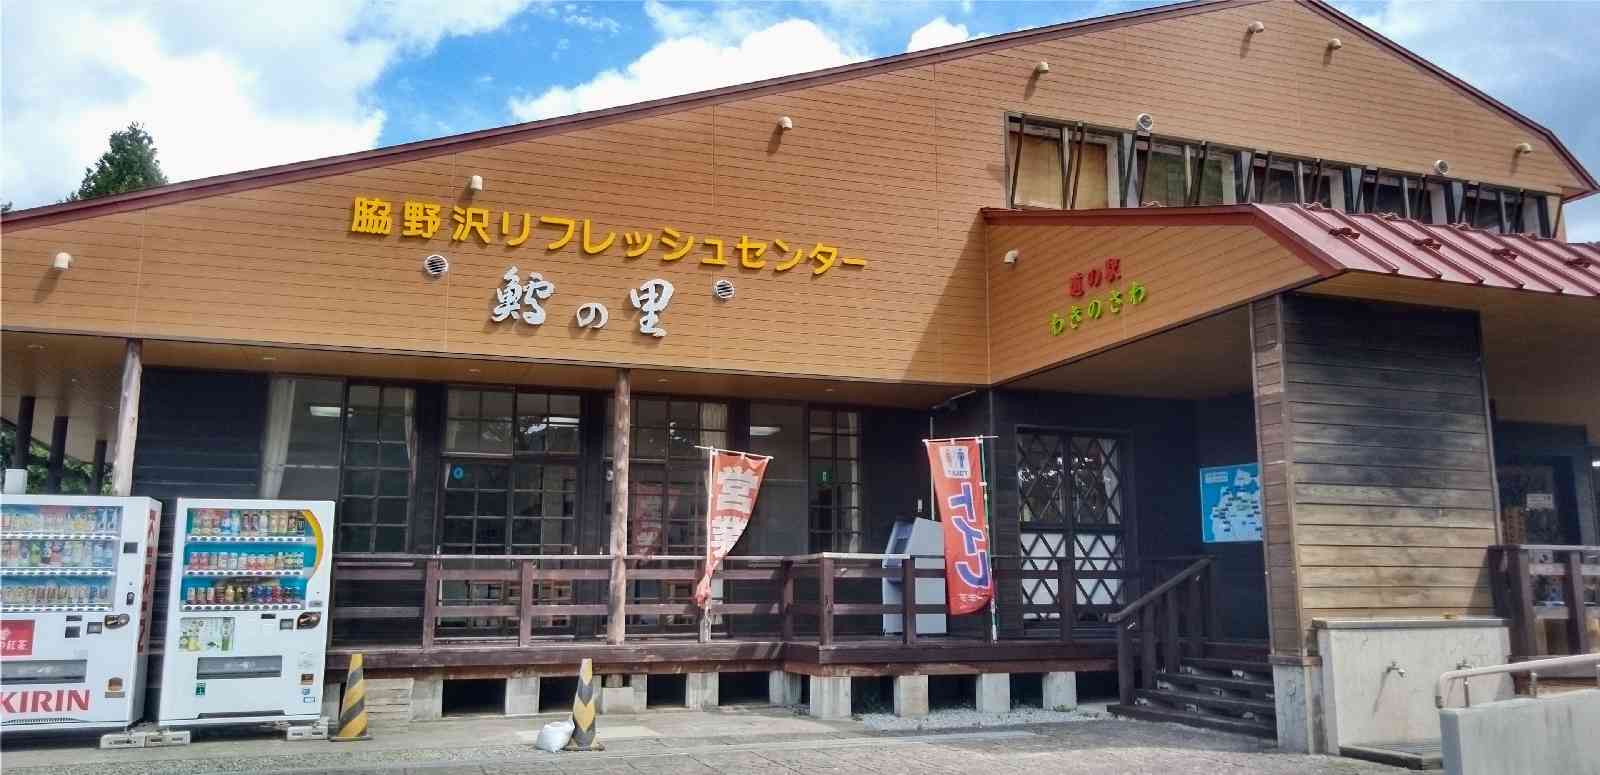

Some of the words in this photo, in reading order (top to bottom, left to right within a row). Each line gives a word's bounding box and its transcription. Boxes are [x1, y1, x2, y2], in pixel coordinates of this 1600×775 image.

[352, 196, 867, 275] 脇野沢リフレッシュセンター
[491, 265, 675, 337] 鱈の里
[1070, 257, 1121, 297] 道の駅
[1049, 281, 1146, 336] わきのさわ
[0, 689, 90, 713] KIRIN
